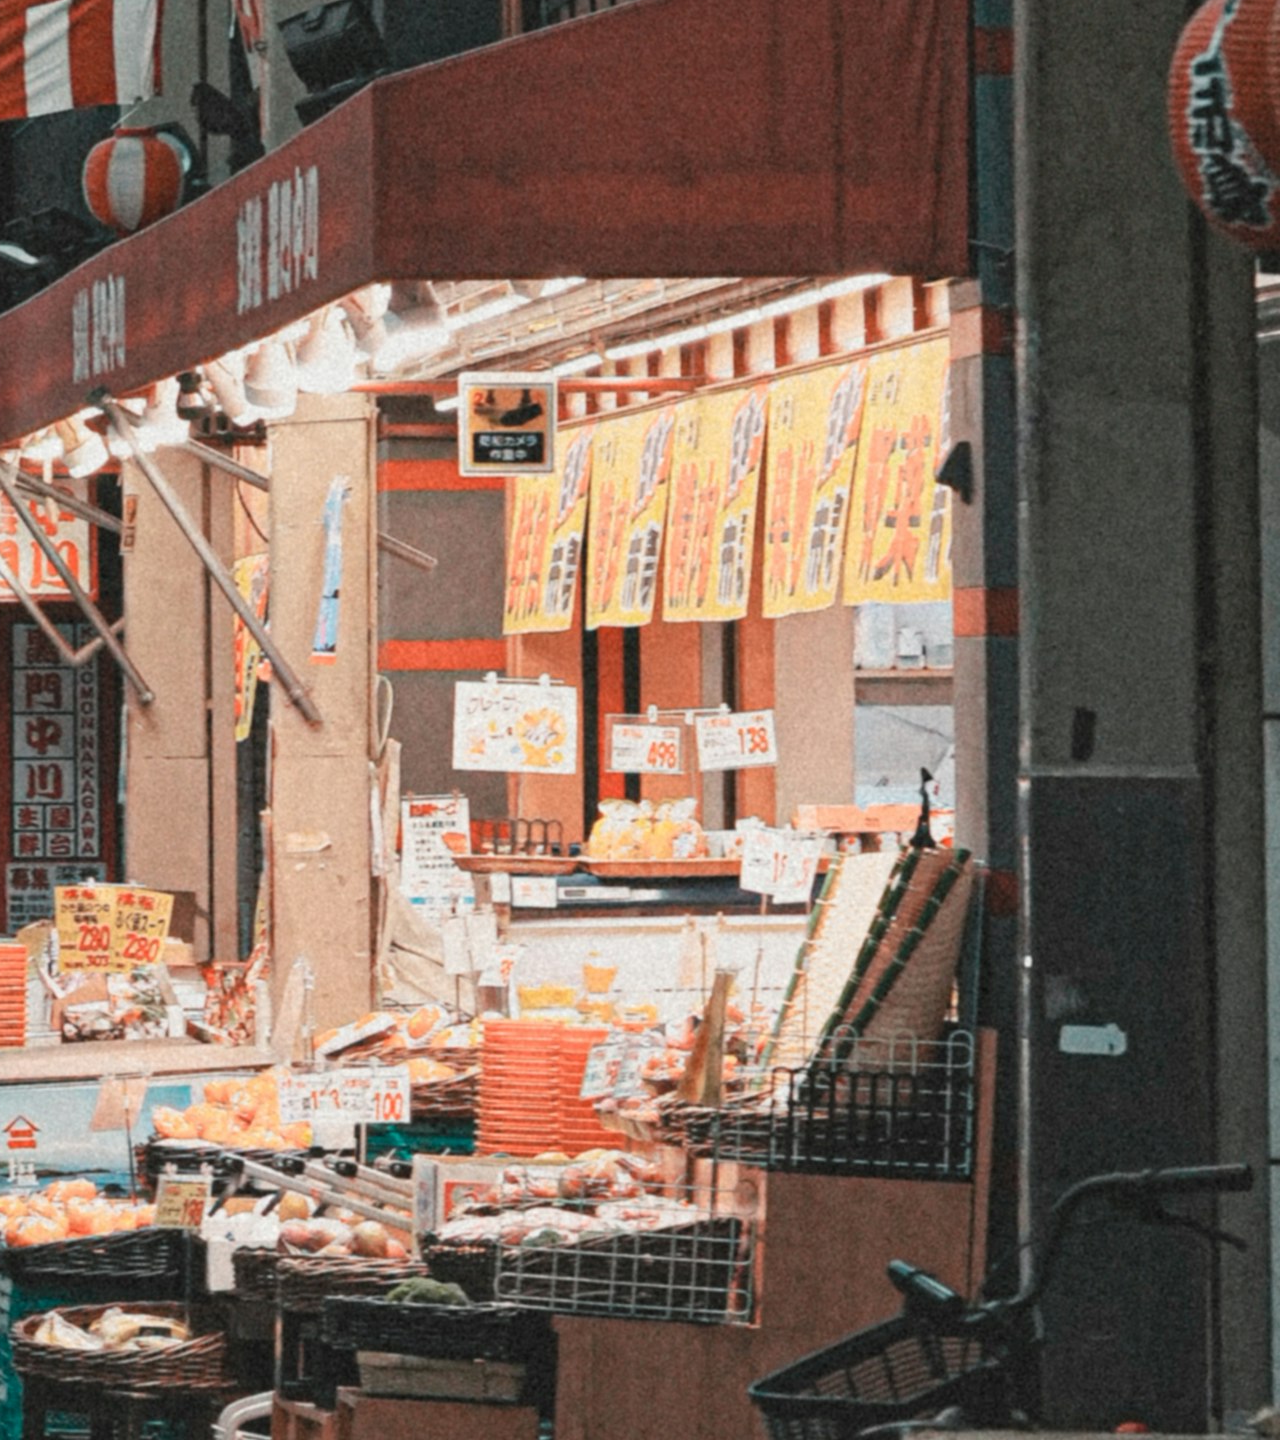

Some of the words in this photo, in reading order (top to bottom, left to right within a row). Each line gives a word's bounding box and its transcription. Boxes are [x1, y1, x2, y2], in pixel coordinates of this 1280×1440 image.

[80, 626, 95, 730] KOMON
[737, 726, 770, 754] 138
[647, 741, 678, 769] 498
[78, 925, 111, 952] 280
[122, 934, 157, 962] 280
[374, 1092, 404, 1120] 100
